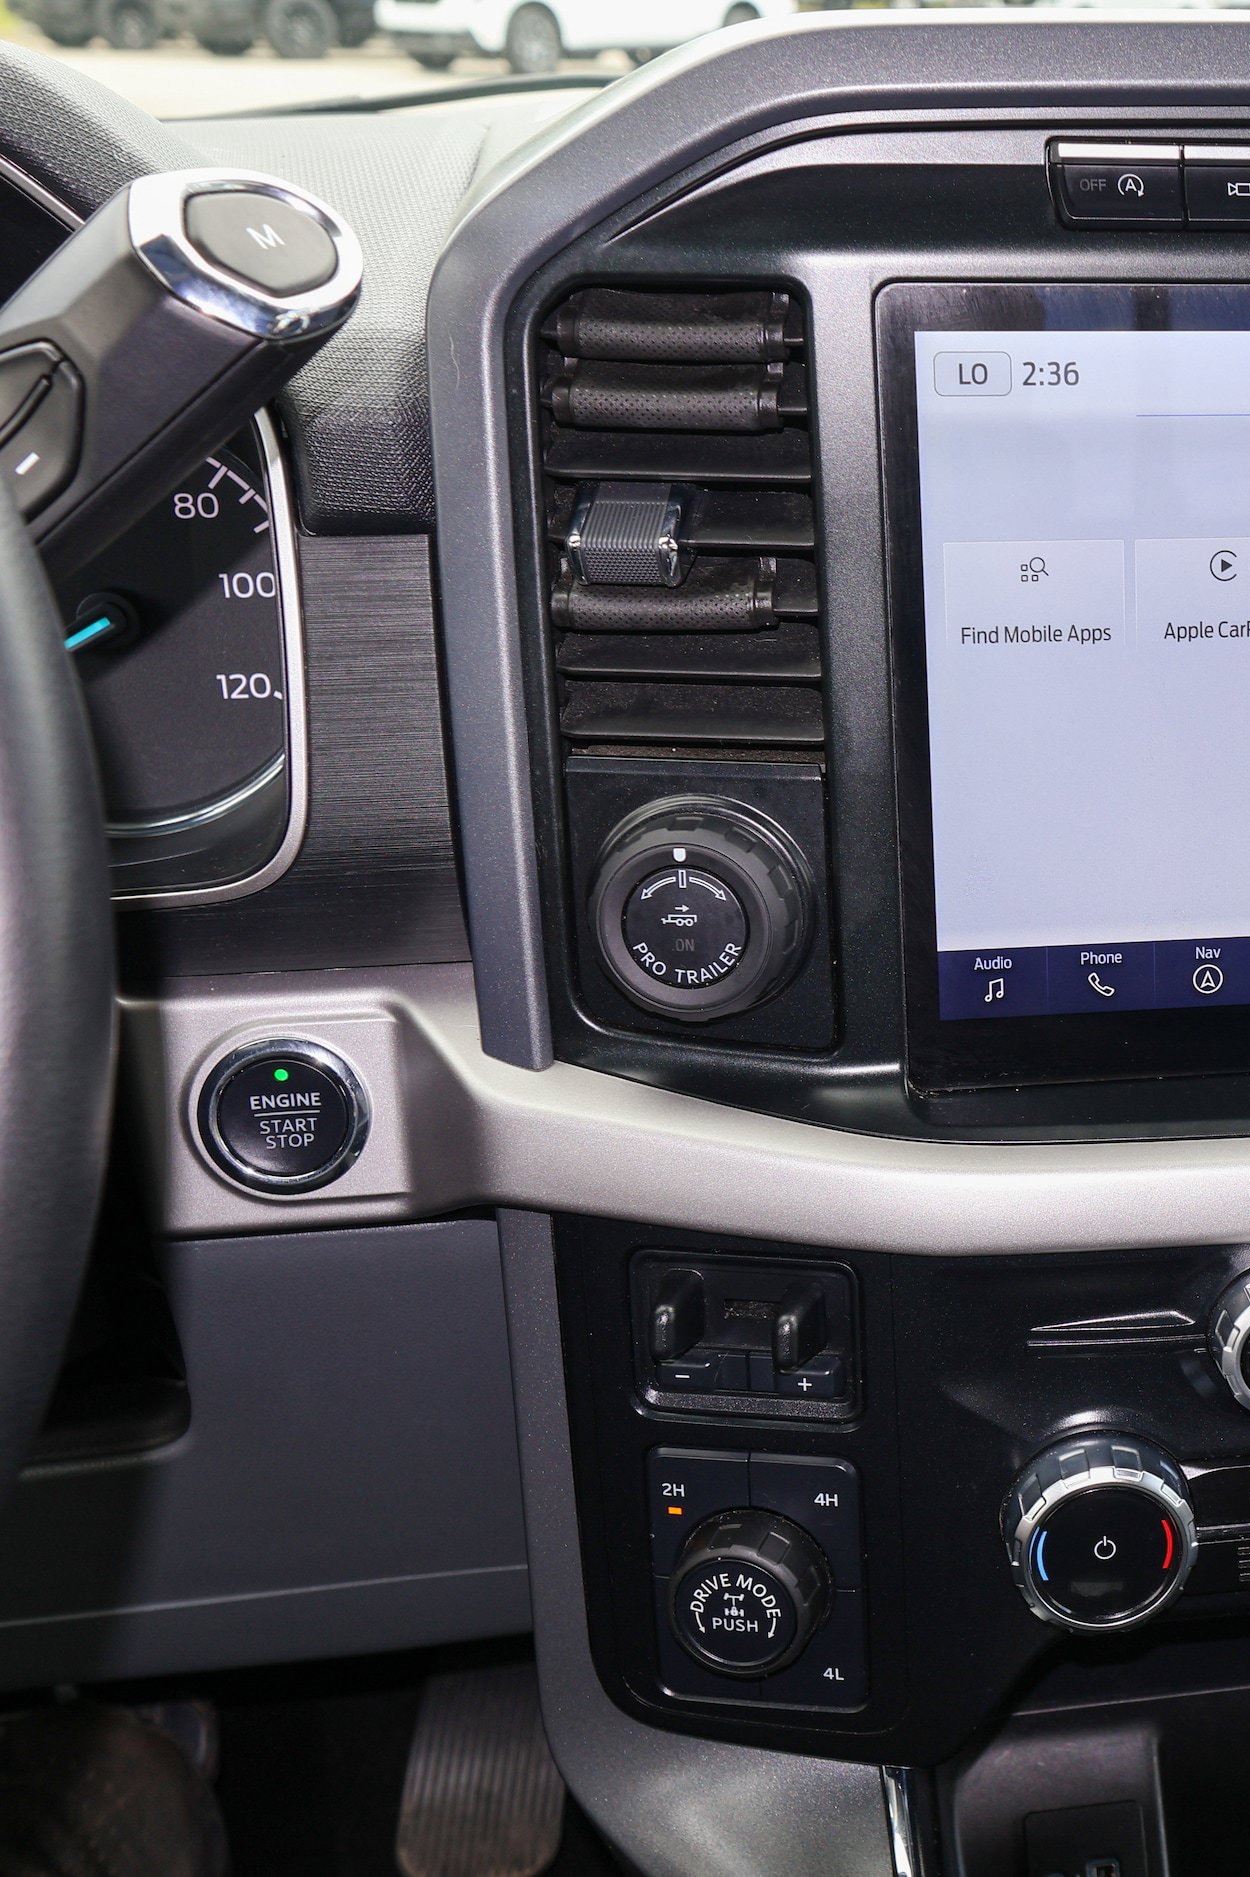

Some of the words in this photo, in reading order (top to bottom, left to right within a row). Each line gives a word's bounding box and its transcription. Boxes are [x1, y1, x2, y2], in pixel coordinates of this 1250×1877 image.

[247, 225, 285, 250] M
[957, 361, 989, 388] LO
[1021, 361, 1081, 389] 2:36
[173, 492, 219, 519] 80
[218, 571, 276, 598] 100
[960, 624, 999, 645] Find
[1004, 625, 1063, 644] Mobile
[1066, 624, 1112, 645] Apps
[1163, 620, 1214, 642] Apple
[216, 673, 271, 700] 120
[674, 938, 695, 952] ON
[1195, 946, 1221, 960] Nav
[633, 942, 667, 976] PRO
[674, 942, 742, 984] TRAILER
[973, 955, 1013, 971] Audio
[1080, 950, 1123, 966] Phone
[250, 1092, 322, 1110] ENGINE
[259, 1117, 318, 1135] START
[266, 1132, 315, 1150] STOP
[661, 1483, 686, 1497] 2H
[814, 1493, 839, 1507] 4H
[690, 1573, 732, 1613] DRIVE
[735, 1574, 782, 1618] MODE
[712, 1617, 759, 1632] PUSH
[823, 1667, 845, 1681] 4L
